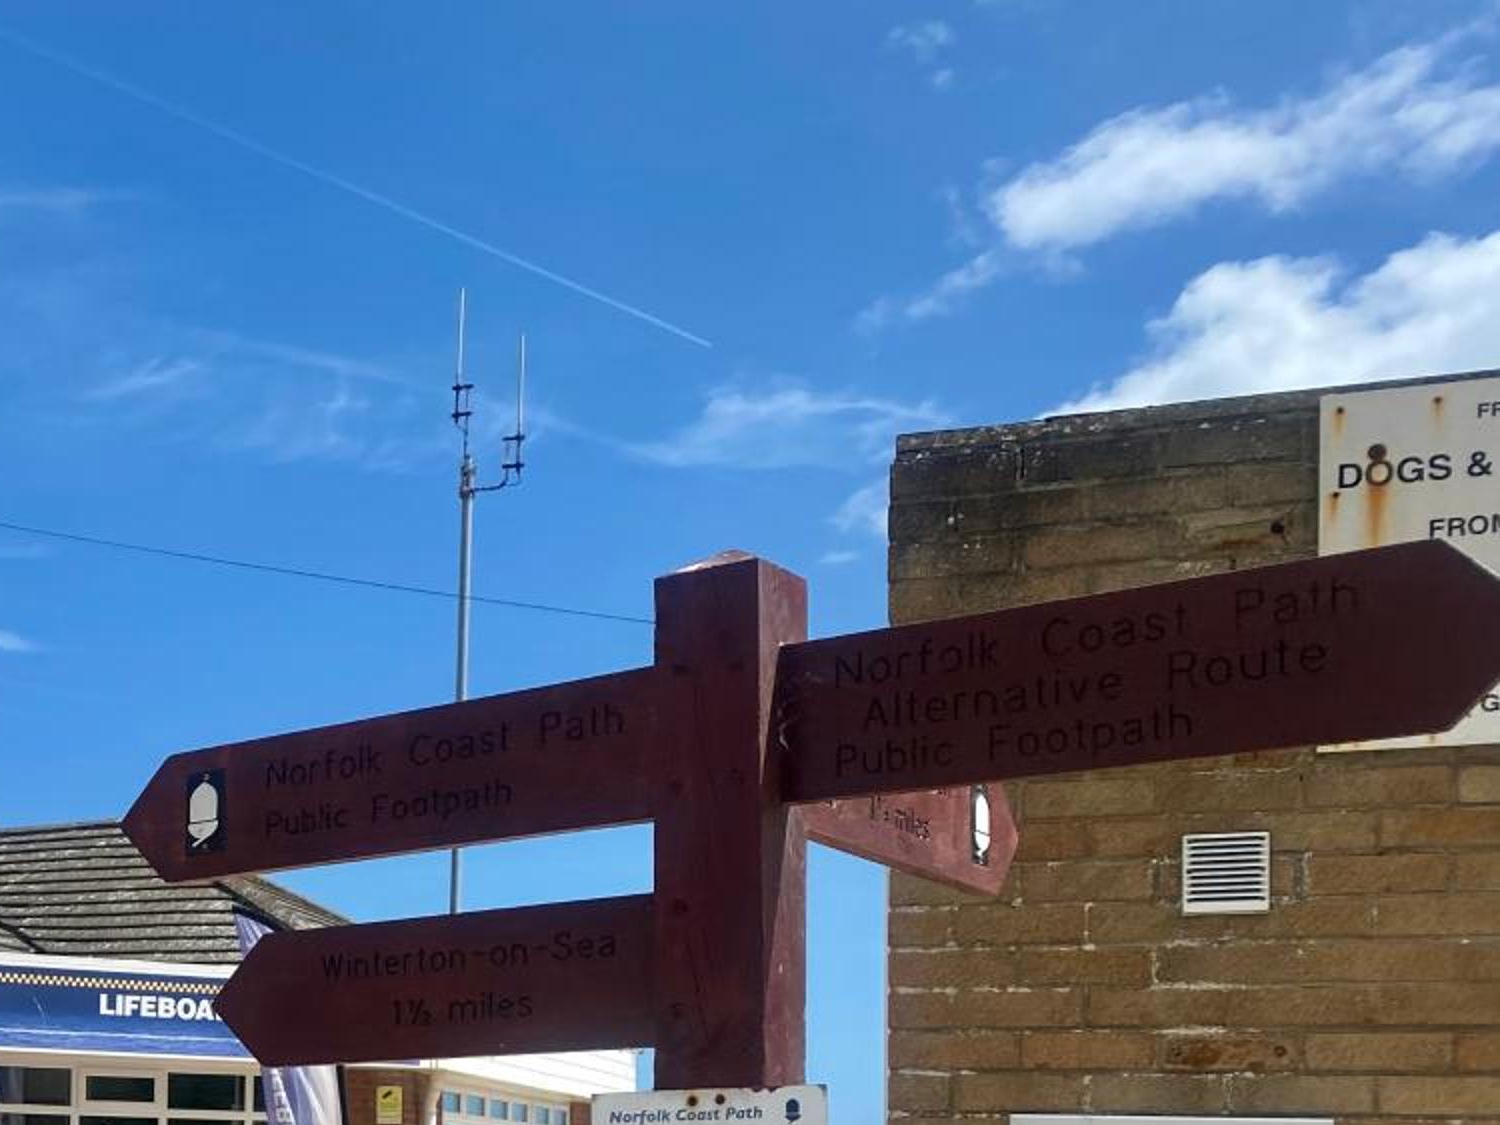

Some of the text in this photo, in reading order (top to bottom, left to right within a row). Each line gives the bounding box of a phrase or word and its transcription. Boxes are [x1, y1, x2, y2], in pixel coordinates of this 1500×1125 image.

[1338, 451, 1493, 489] DOGS &
[834, 576, 1359, 689] Norfolk Coast Path
[863, 639, 1329, 731] Alternative Route
[265, 705, 625, 789] Norfolk Coast Path
[835, 705, 1194, 778] Public Footpath
[265, 782, 513, 837] Public Footpath
[322, 930, 617, 981] Winterton-on-Sea
[99, 993, 224, 1021] LIFEBOA
[449, 993, 533, 1023] miles
[609, 1106, 763, 1125] Norfolk Coast Path
